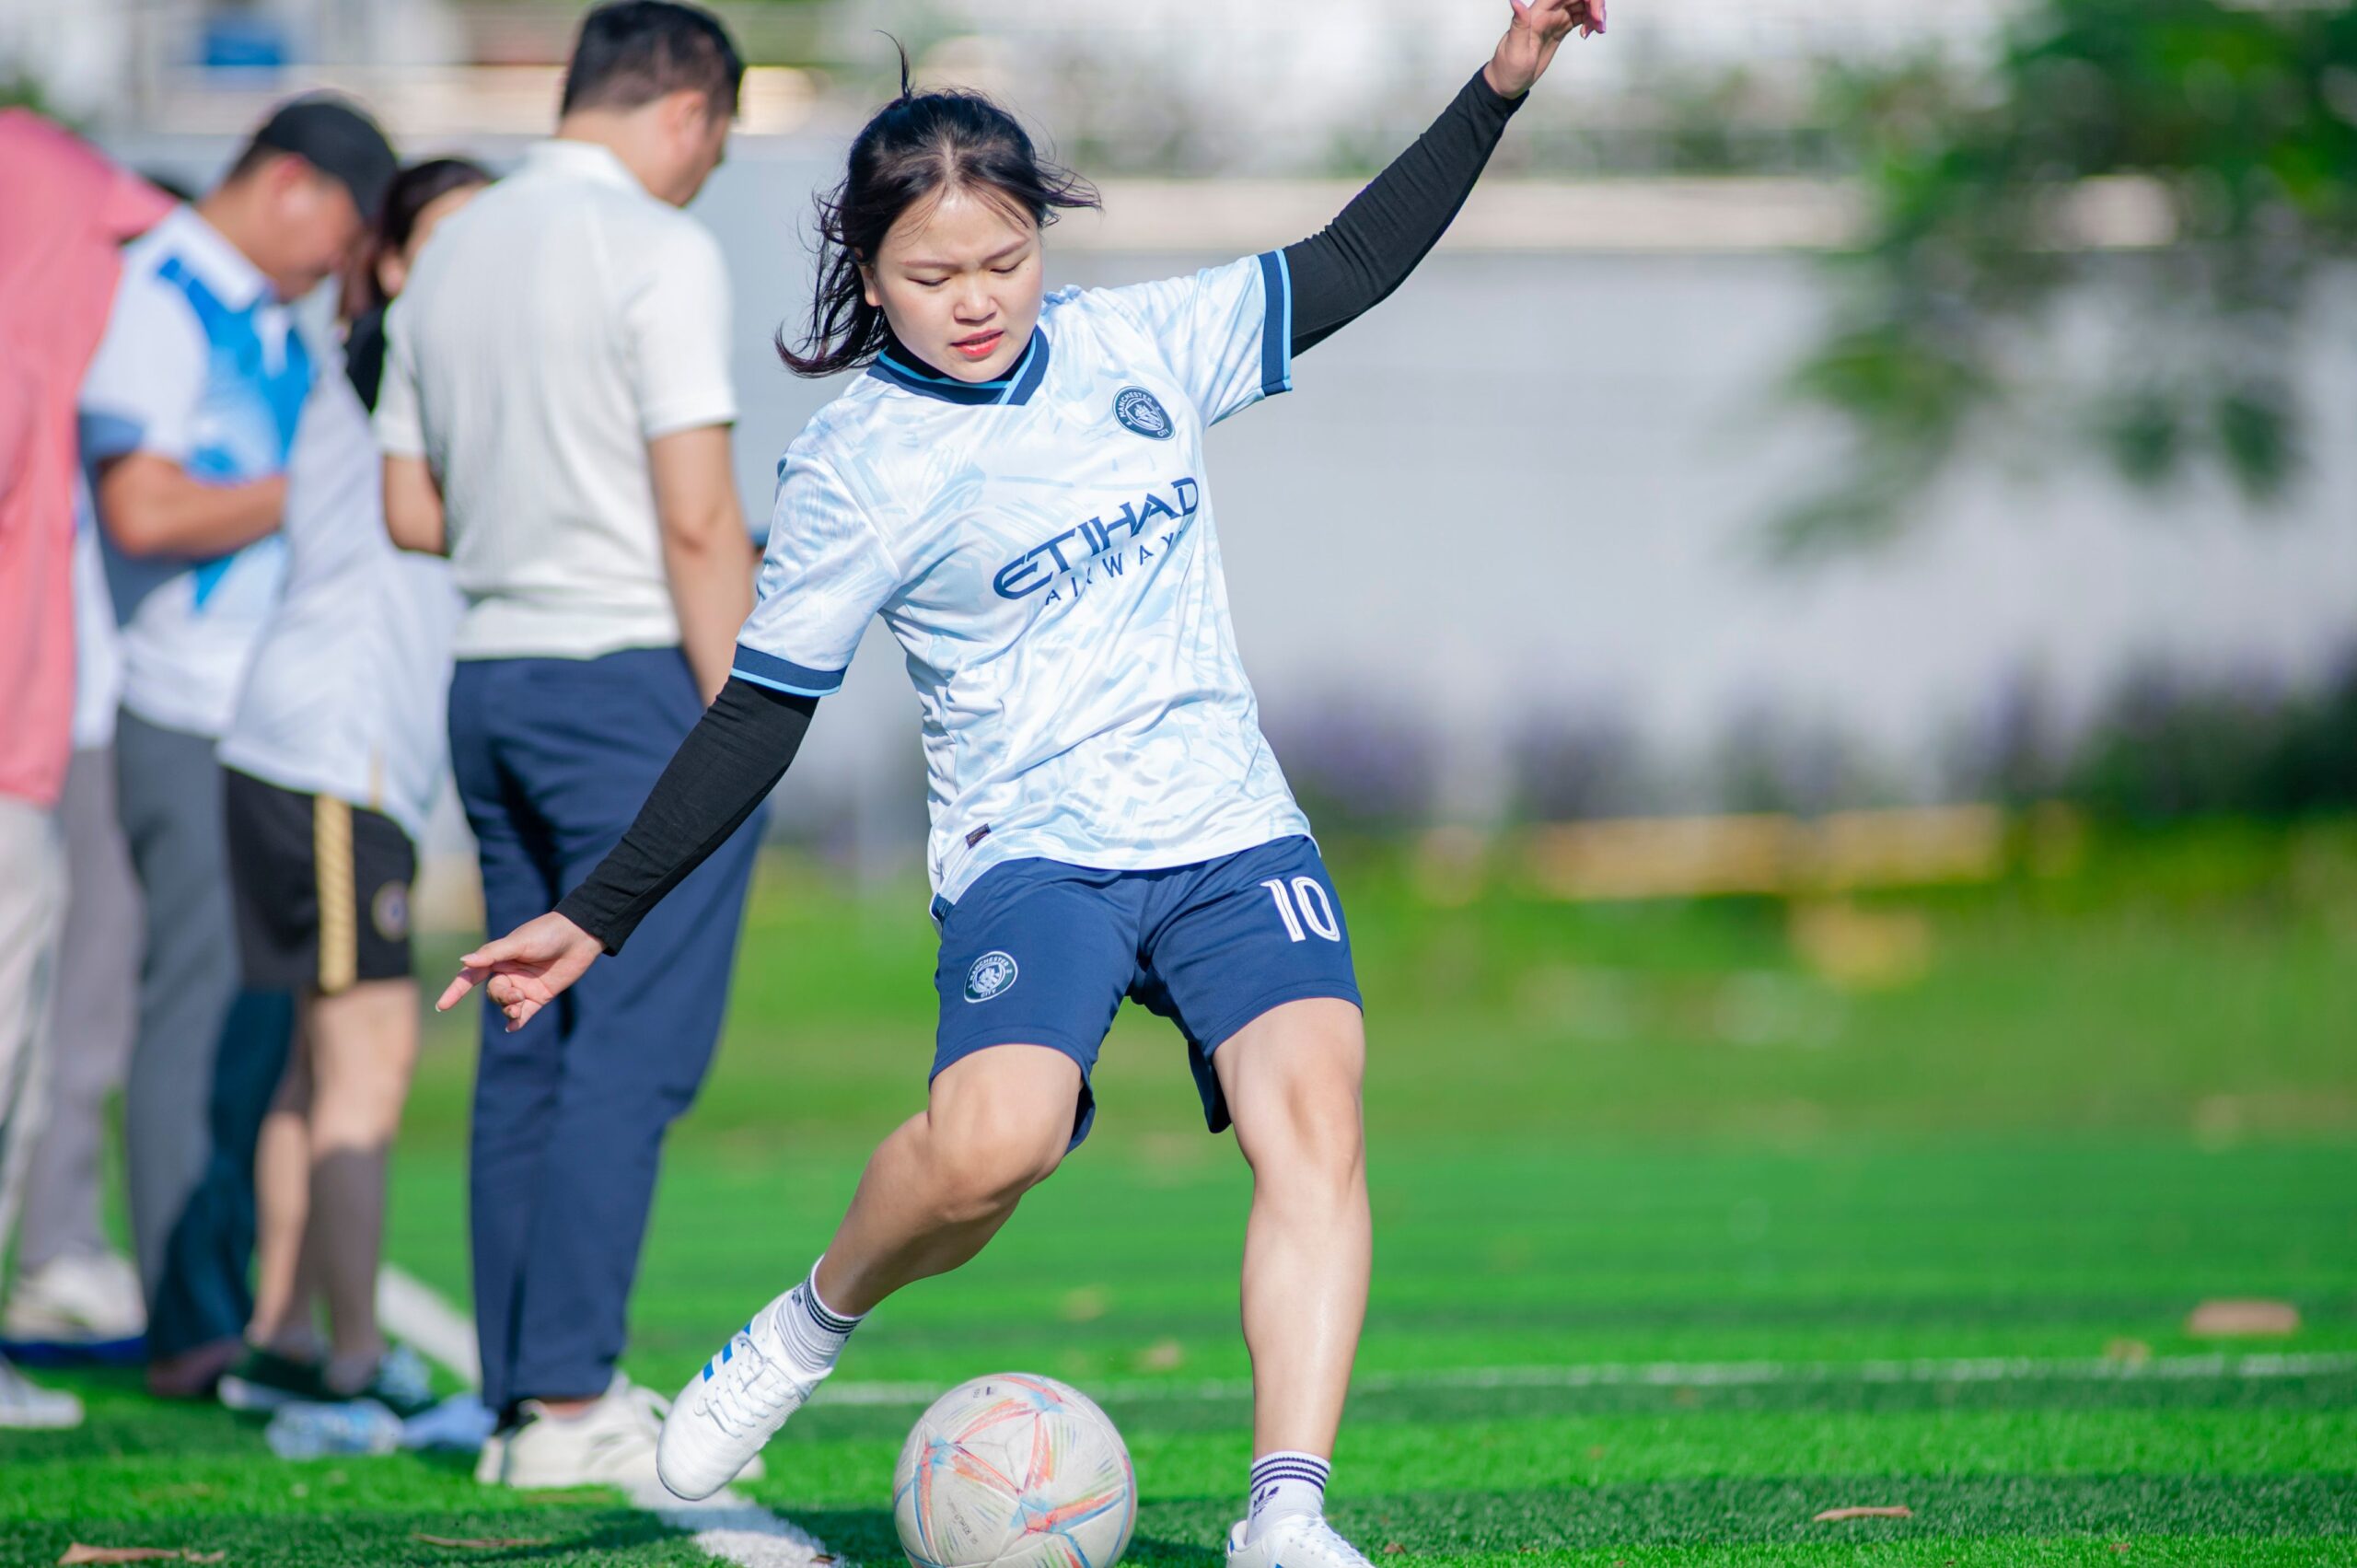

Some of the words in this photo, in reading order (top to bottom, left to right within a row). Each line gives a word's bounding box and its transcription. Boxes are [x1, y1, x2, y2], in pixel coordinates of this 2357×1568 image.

[1118, 391, 1152, 418] MANCHESTER
[993, 477, 1198, 599] ETIHAD
[1045, 530, 1182, 606] AIWAY
[1260, 877, 1341, 943] 10
